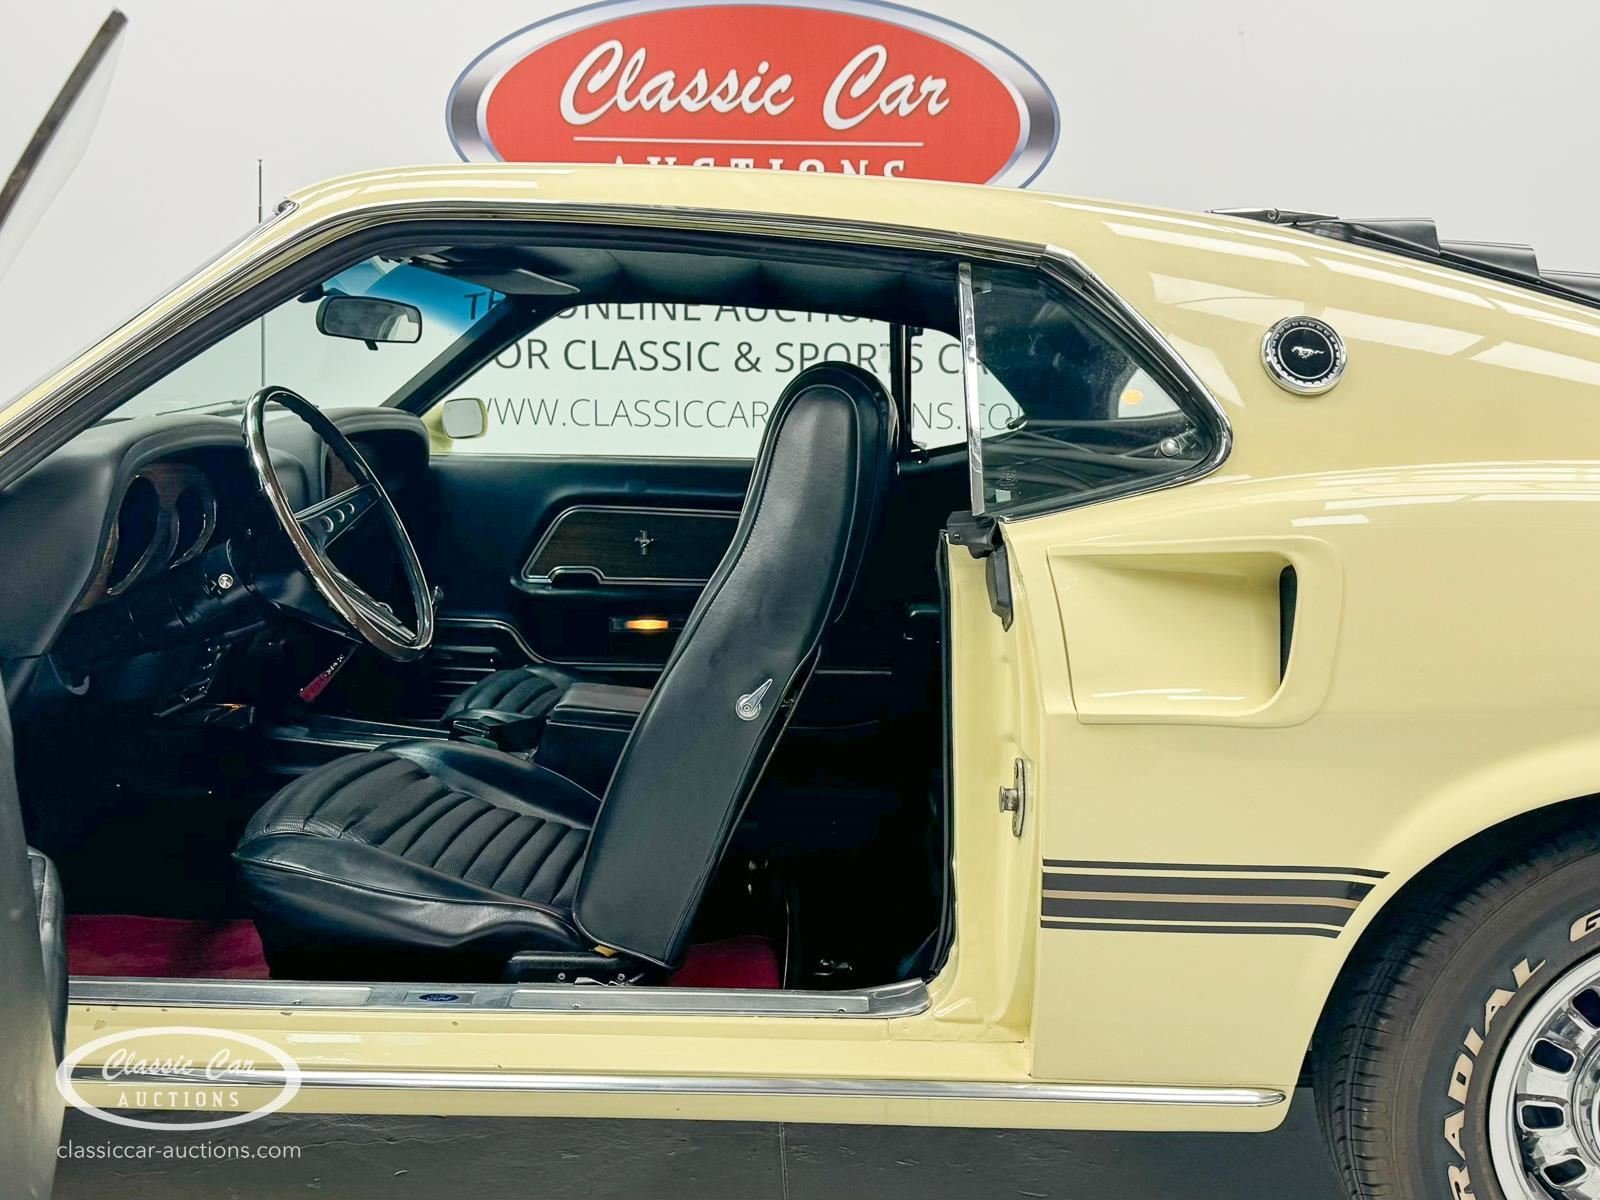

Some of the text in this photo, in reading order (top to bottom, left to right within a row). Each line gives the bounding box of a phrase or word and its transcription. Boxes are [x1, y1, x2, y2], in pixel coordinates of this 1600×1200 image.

[559, 39, 950, 131] Classic Car
[494, 338, 551, 370] OR
[563, 339, 721, 373] CLASSIC
[733, 341, 762, 373] &
[1444, 957, 1547, 1200] RADIAL
